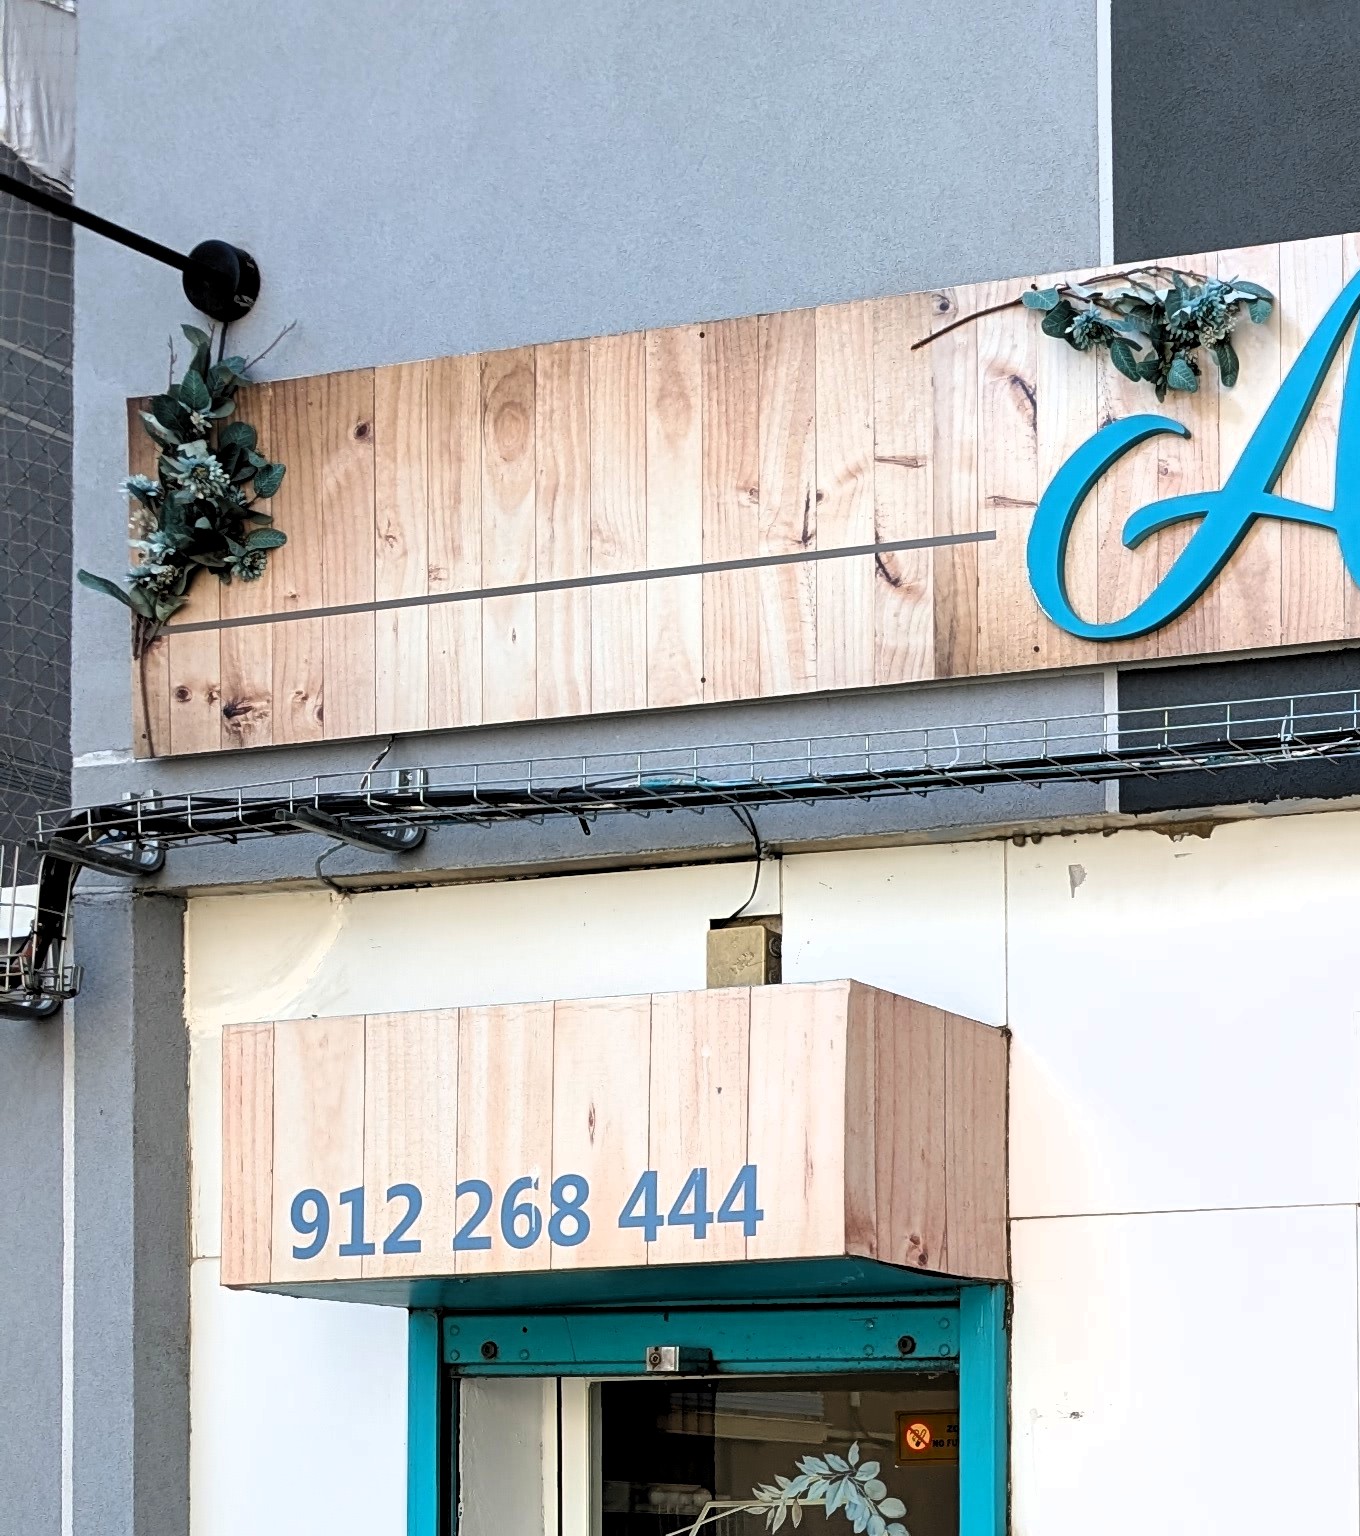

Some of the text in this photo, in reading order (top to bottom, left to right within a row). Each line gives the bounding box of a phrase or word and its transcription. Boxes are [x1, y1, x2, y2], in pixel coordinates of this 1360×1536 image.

[290, 1164, 764, 1260] 912 268 444
[932, 1440, 945, 1448] NO
